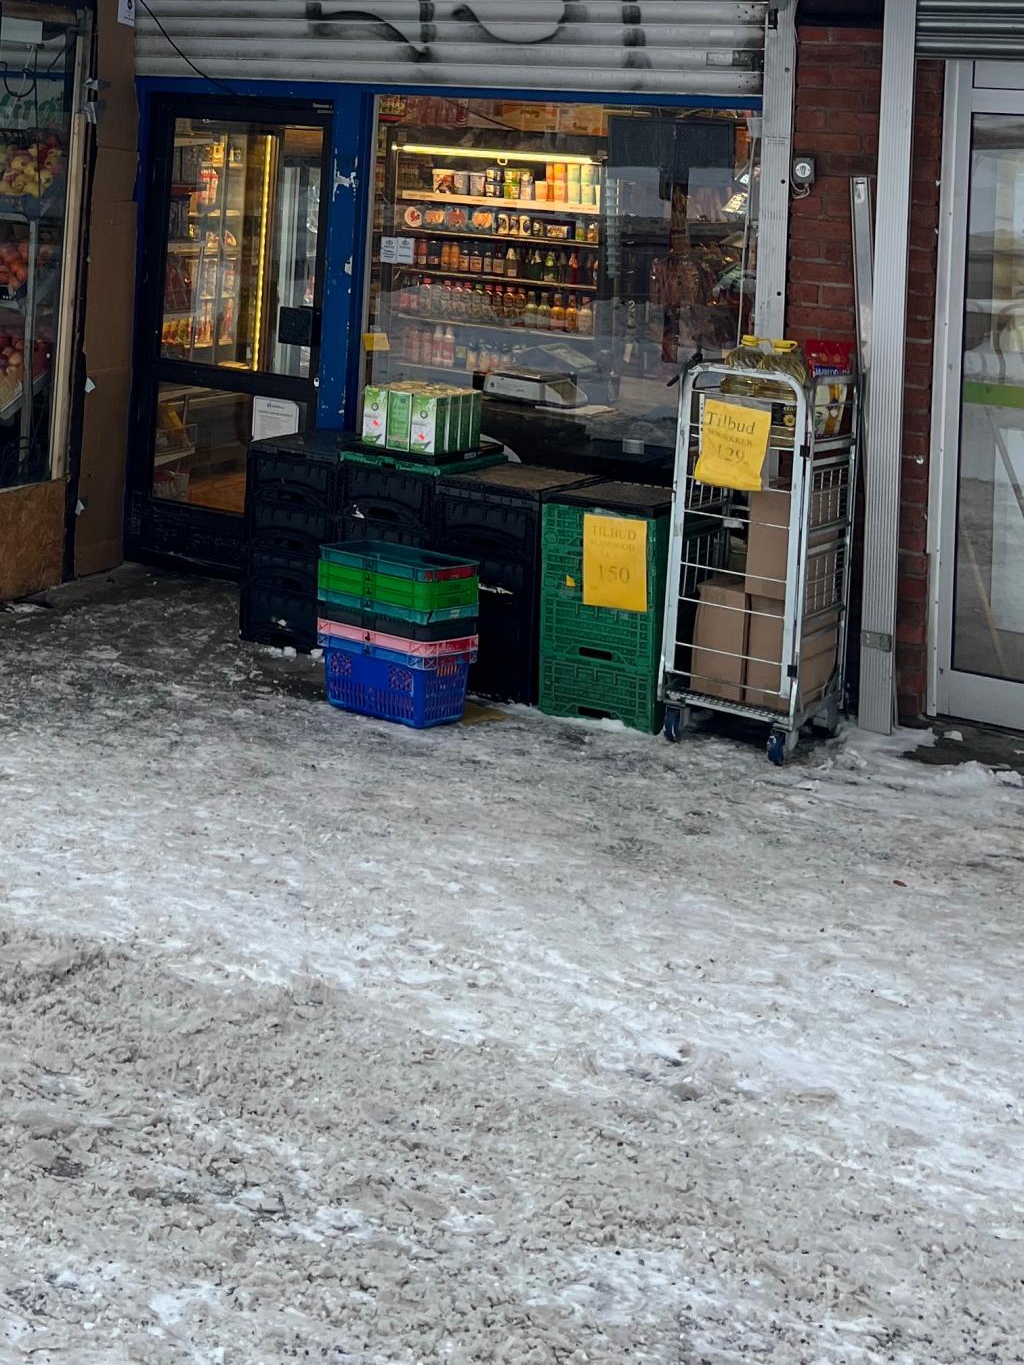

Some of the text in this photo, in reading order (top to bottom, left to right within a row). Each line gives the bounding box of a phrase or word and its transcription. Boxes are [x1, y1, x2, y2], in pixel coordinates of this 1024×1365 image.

[706, 411, 756, 435] Tilbud
[593, 525, 637, 541] TILBUD
[598, 564, 631, 584] 150
